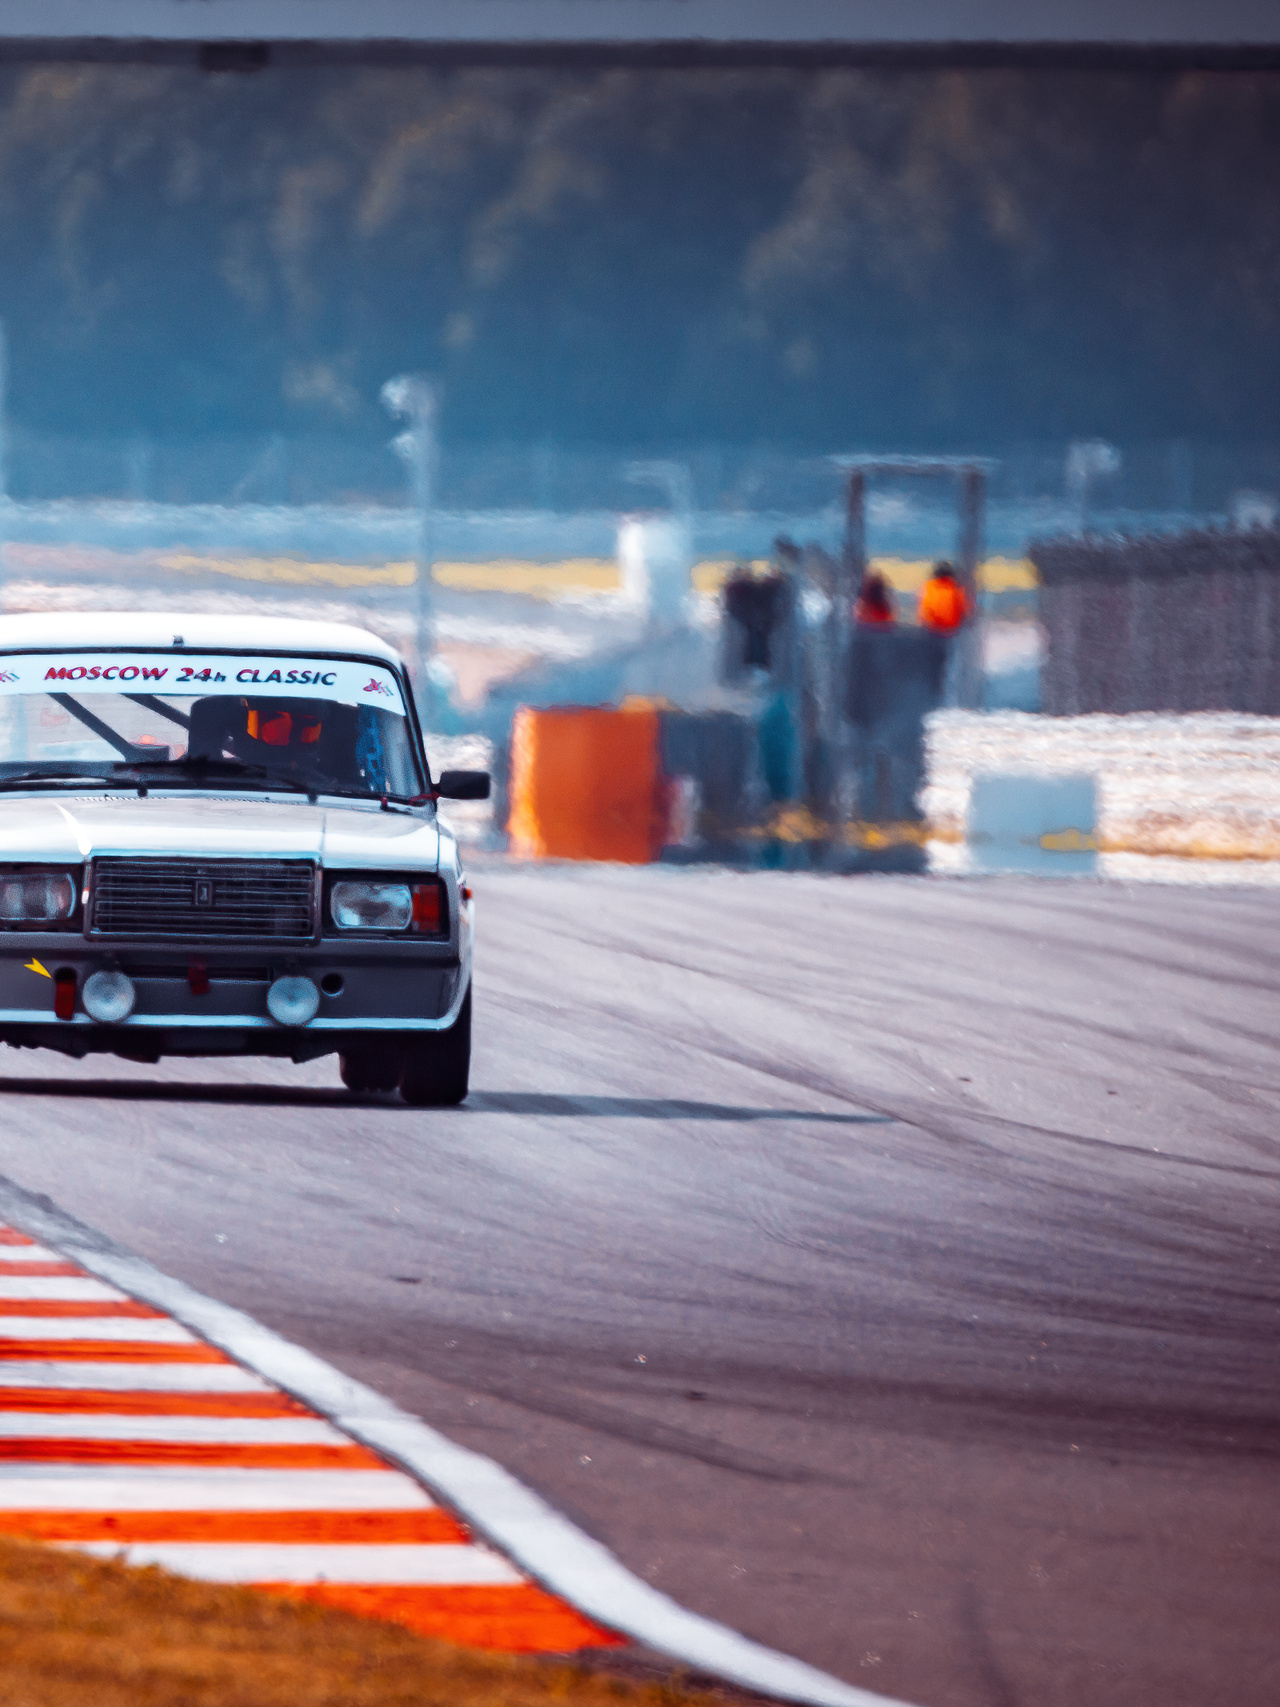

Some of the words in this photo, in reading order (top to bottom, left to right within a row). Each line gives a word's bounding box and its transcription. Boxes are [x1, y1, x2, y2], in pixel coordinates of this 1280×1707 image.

[43, 666, 168, 680] MOSCOW
[176, 667, 226, 682] 24h
[236, 668, 338, 686] CLASSIC
